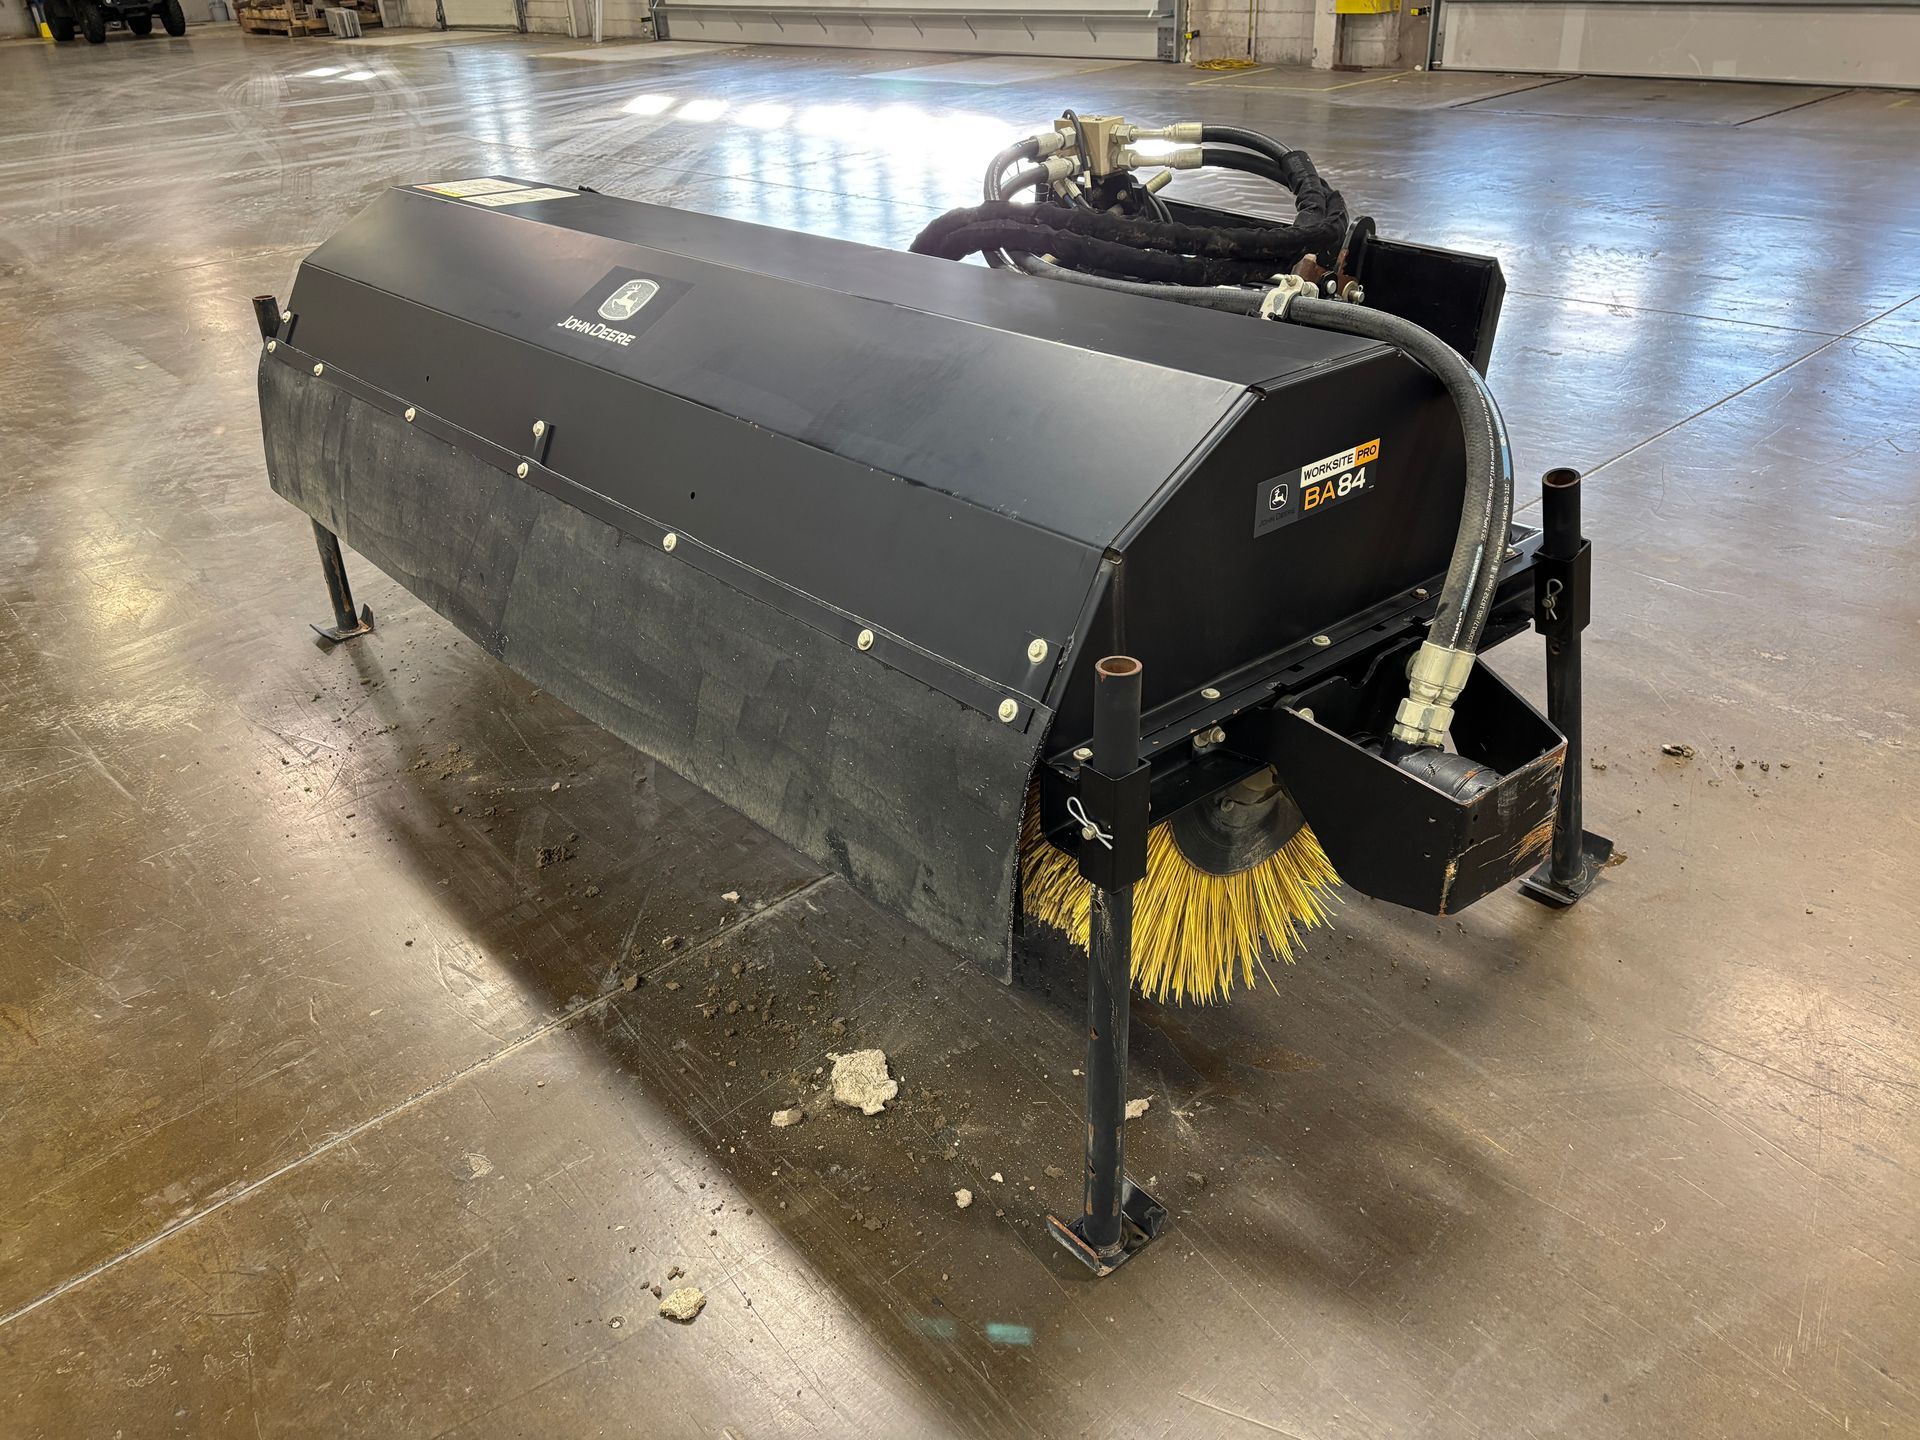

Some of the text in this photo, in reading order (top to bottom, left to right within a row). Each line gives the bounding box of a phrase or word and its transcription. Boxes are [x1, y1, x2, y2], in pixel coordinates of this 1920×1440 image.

[557, 315, 636, 346] JOHN DEERE
[1303, 444, 1377, 481] WORKSITE PRO
[1304, 466, 1366, 511] BA84
[1493, 547, 1502, 563] Flame
[1498, 521, 1508, 546] Resistant
